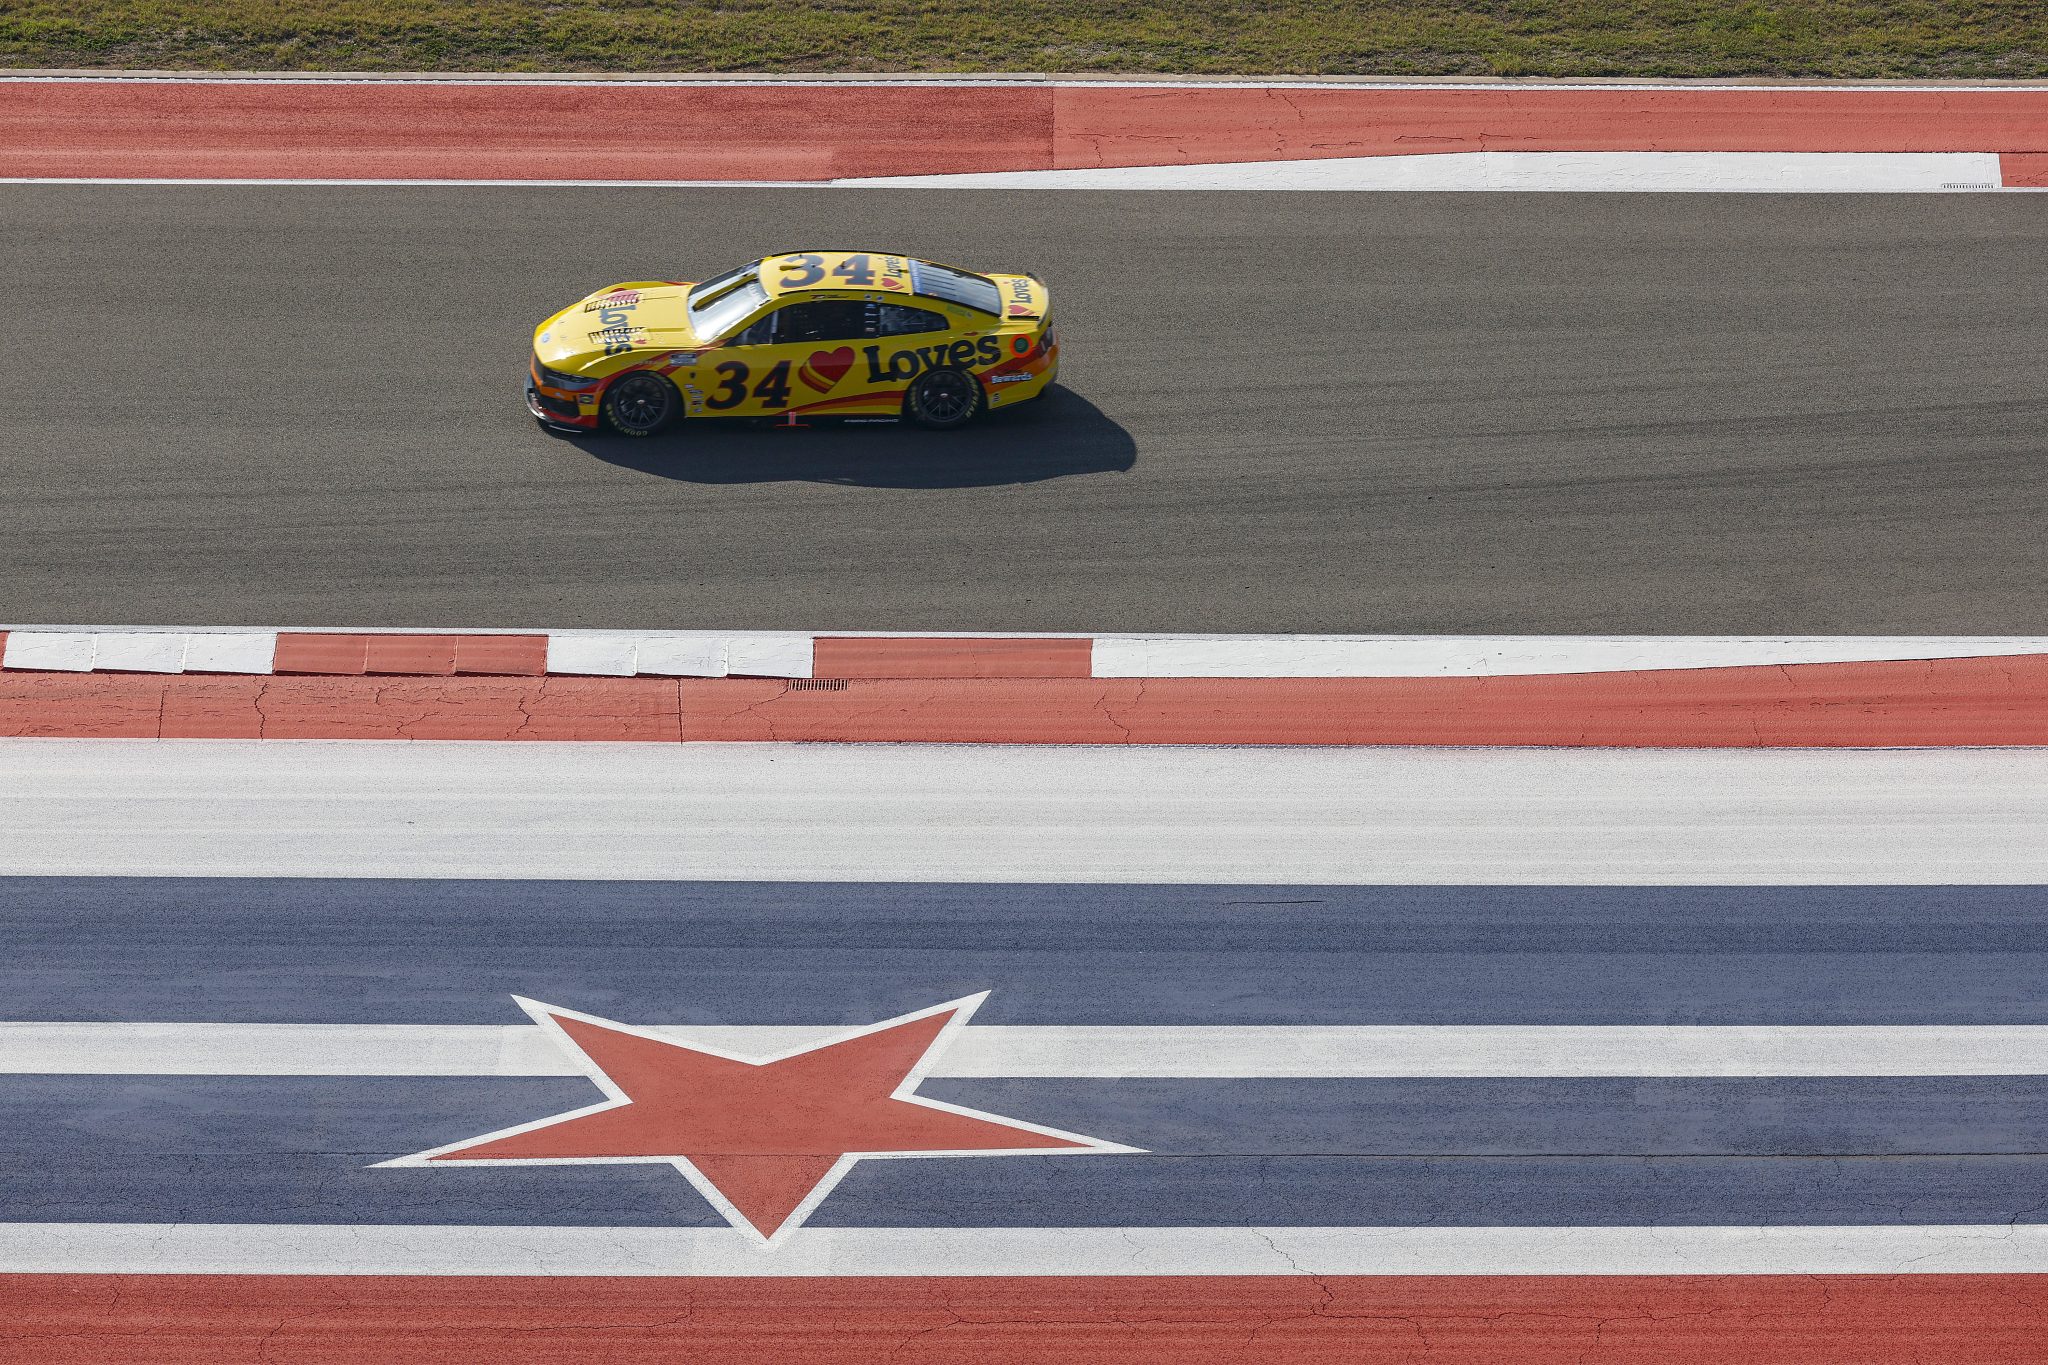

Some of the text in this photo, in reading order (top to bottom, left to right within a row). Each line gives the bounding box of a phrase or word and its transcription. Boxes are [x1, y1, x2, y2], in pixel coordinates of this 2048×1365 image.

[779, 253, 876, 289] 34
[705, 359, 793, 411] 34
[991, 371, 1034, 385] Rewards
